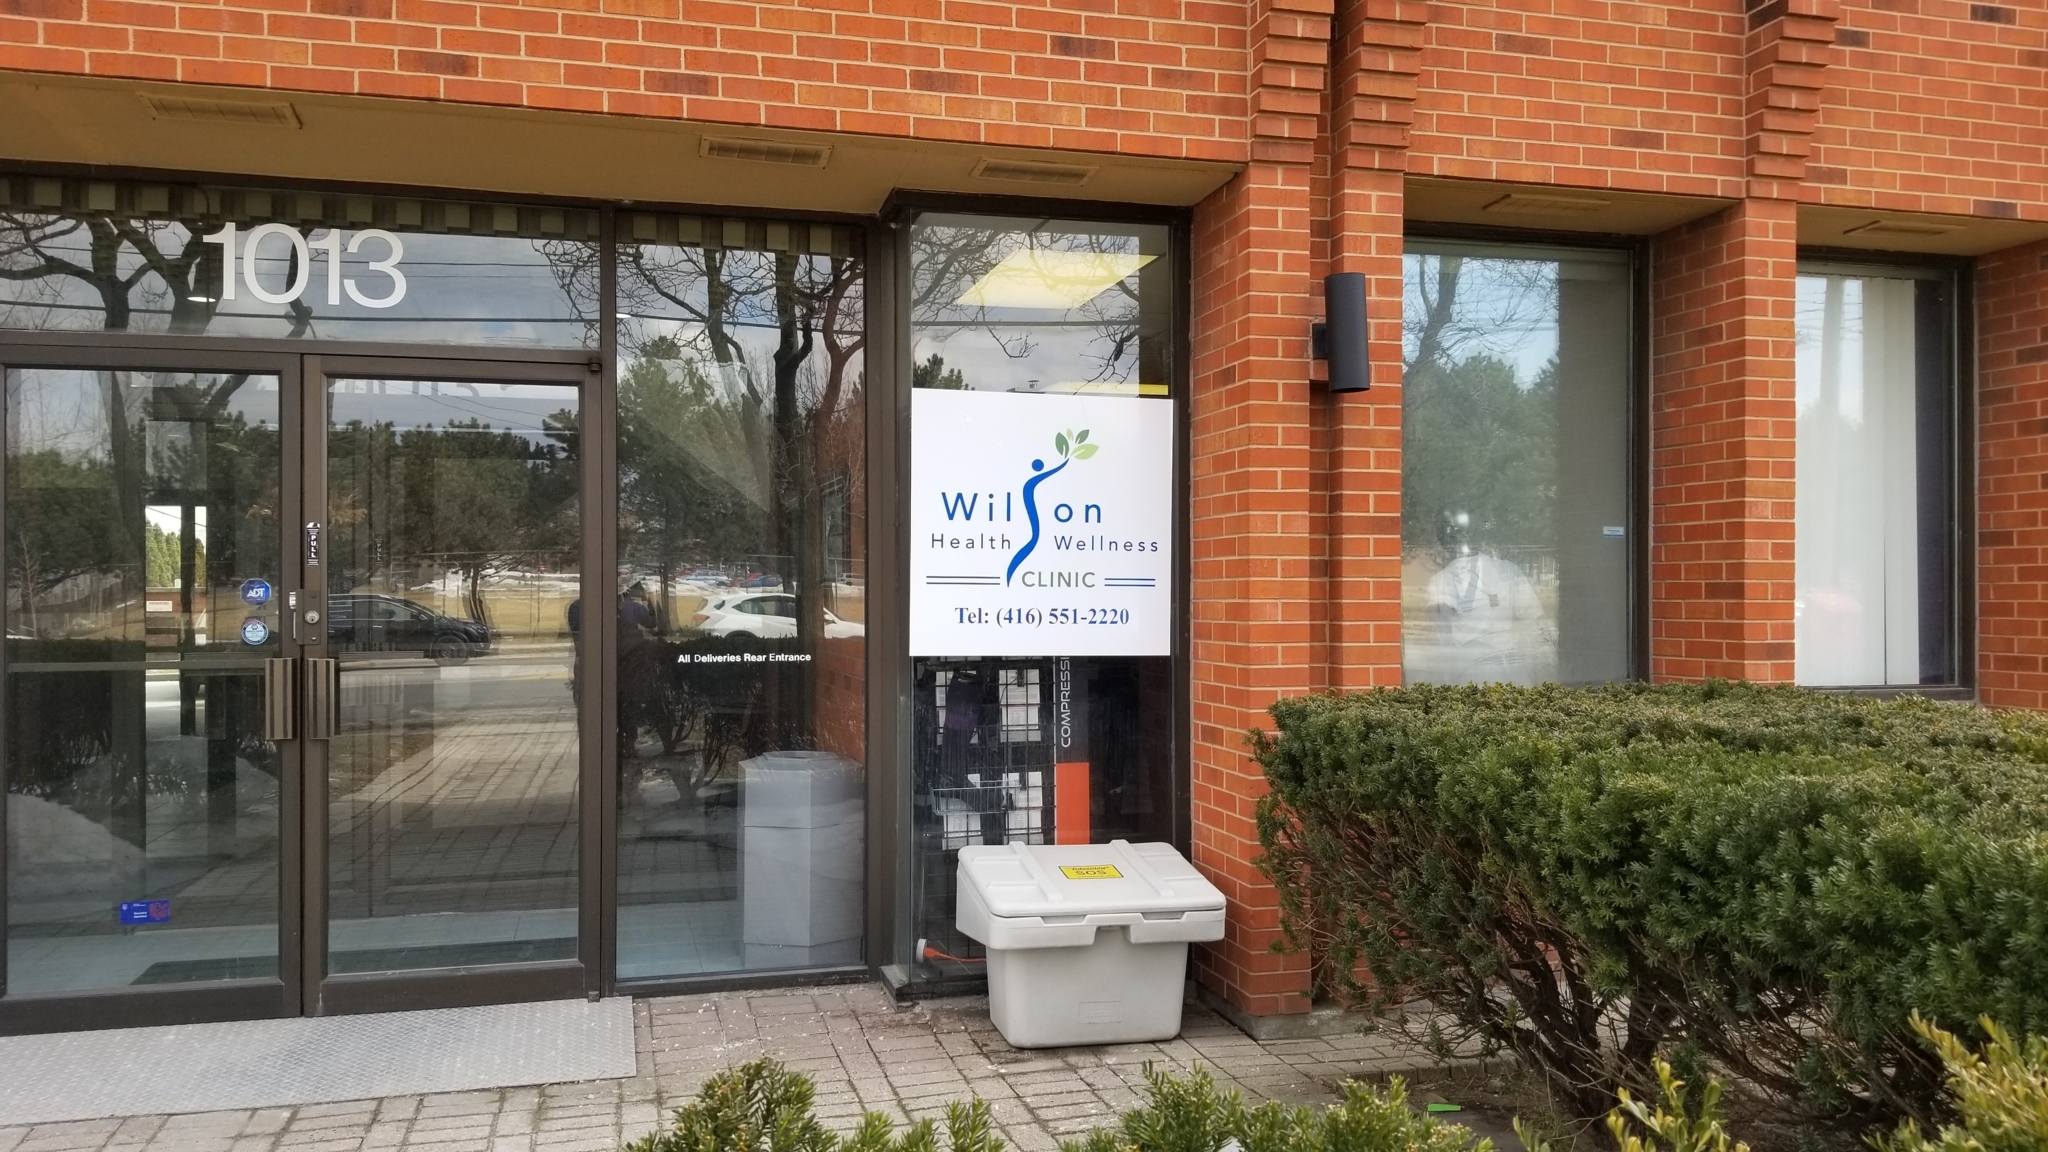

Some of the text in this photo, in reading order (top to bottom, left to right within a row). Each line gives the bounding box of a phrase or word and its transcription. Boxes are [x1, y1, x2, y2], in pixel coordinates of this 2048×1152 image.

[203, 222, 407, 308] 1013
[931, 533, 1158, 552] Health Wellness
[1021, 571, 1096, 588] CLINIC
[246, 588, 266, 598] ADT
[955, 607, 1129, 628] Tel: (416) 551-2220
[677, 653, 812, 663] All Deliveries Rear Entrance
